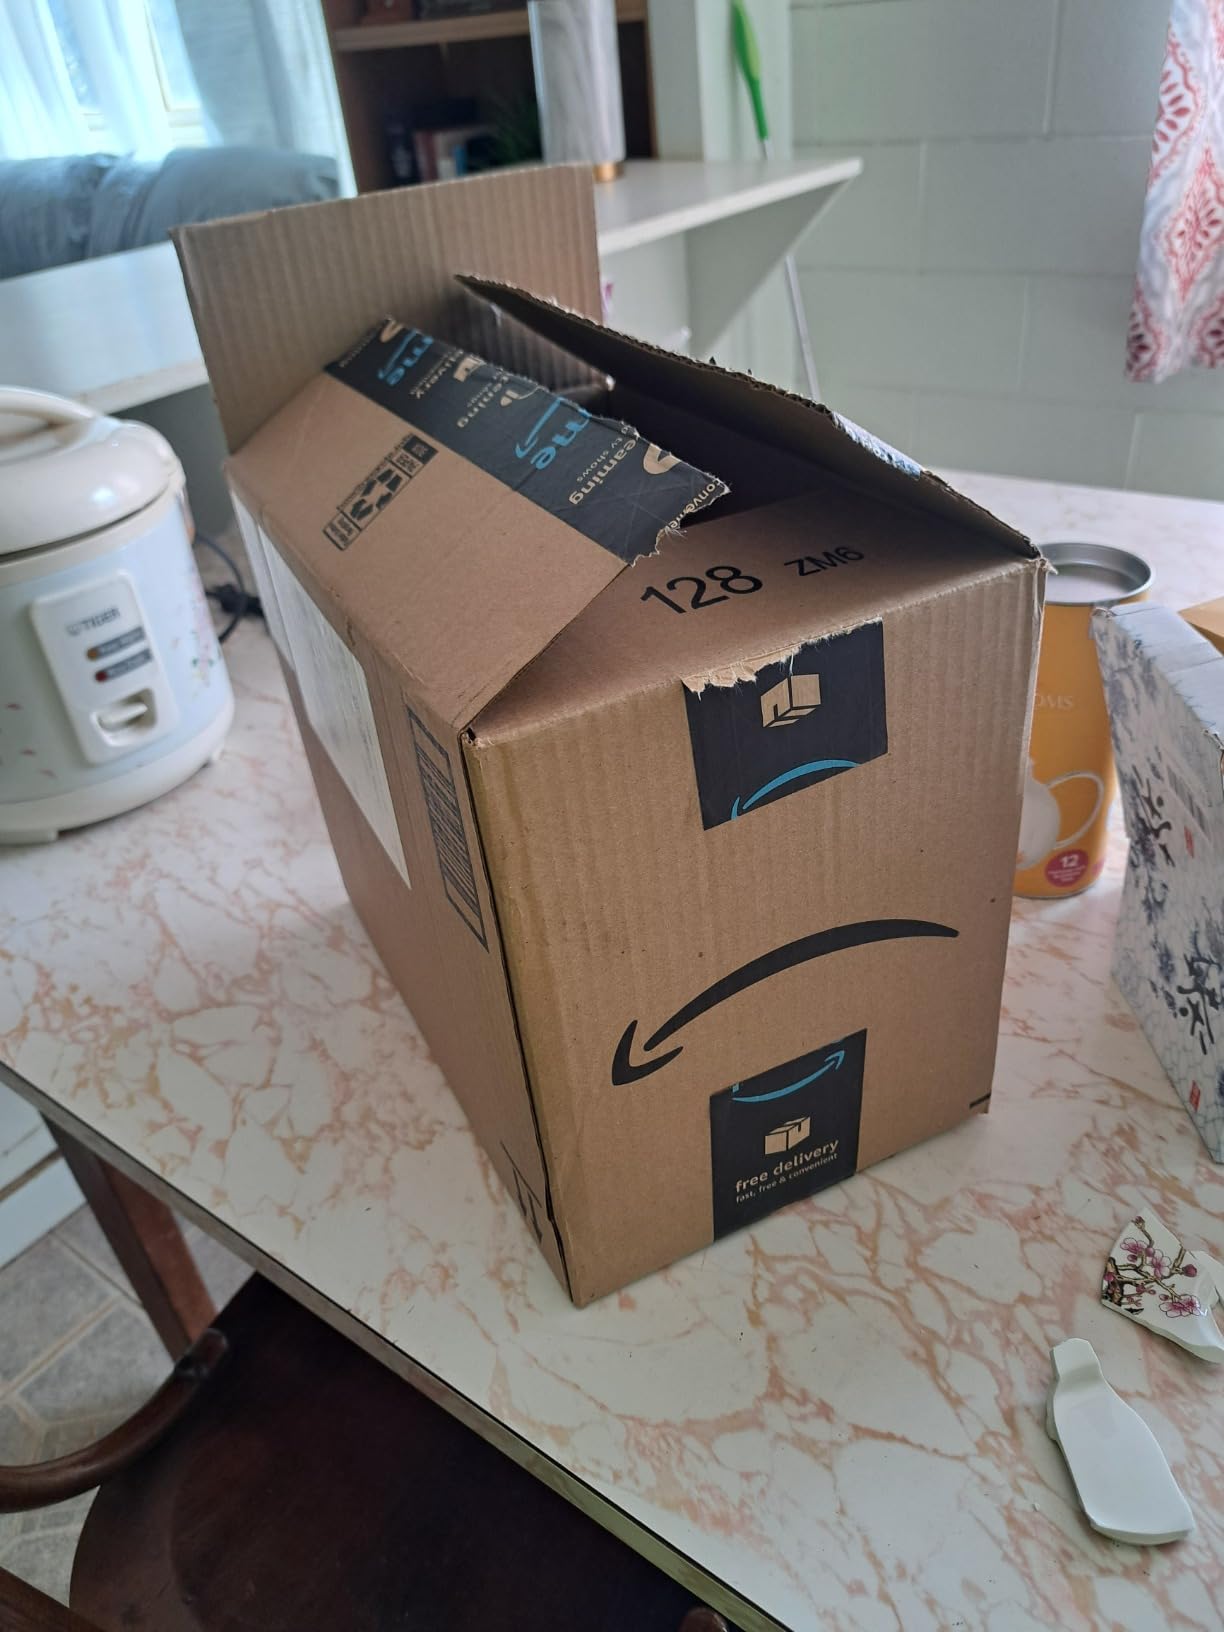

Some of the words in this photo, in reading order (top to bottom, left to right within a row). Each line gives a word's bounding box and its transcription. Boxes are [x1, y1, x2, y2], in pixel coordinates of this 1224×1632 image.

[568, 438, 637, 505] eaming
[577, 450, 609, 482] shows
[640, 565, 763, 614] 128
[784, 546, 864, 577] ZM6
[1060, 853, 1079, 868] 12
[736, 1171, 769, 1193] free
[773, 1140, 839, 1176] delivery
[758, 1181, 778, 1193] free
[779, 1176, 787, 1184] &
[788, 1152, 839, 1180] convenient
